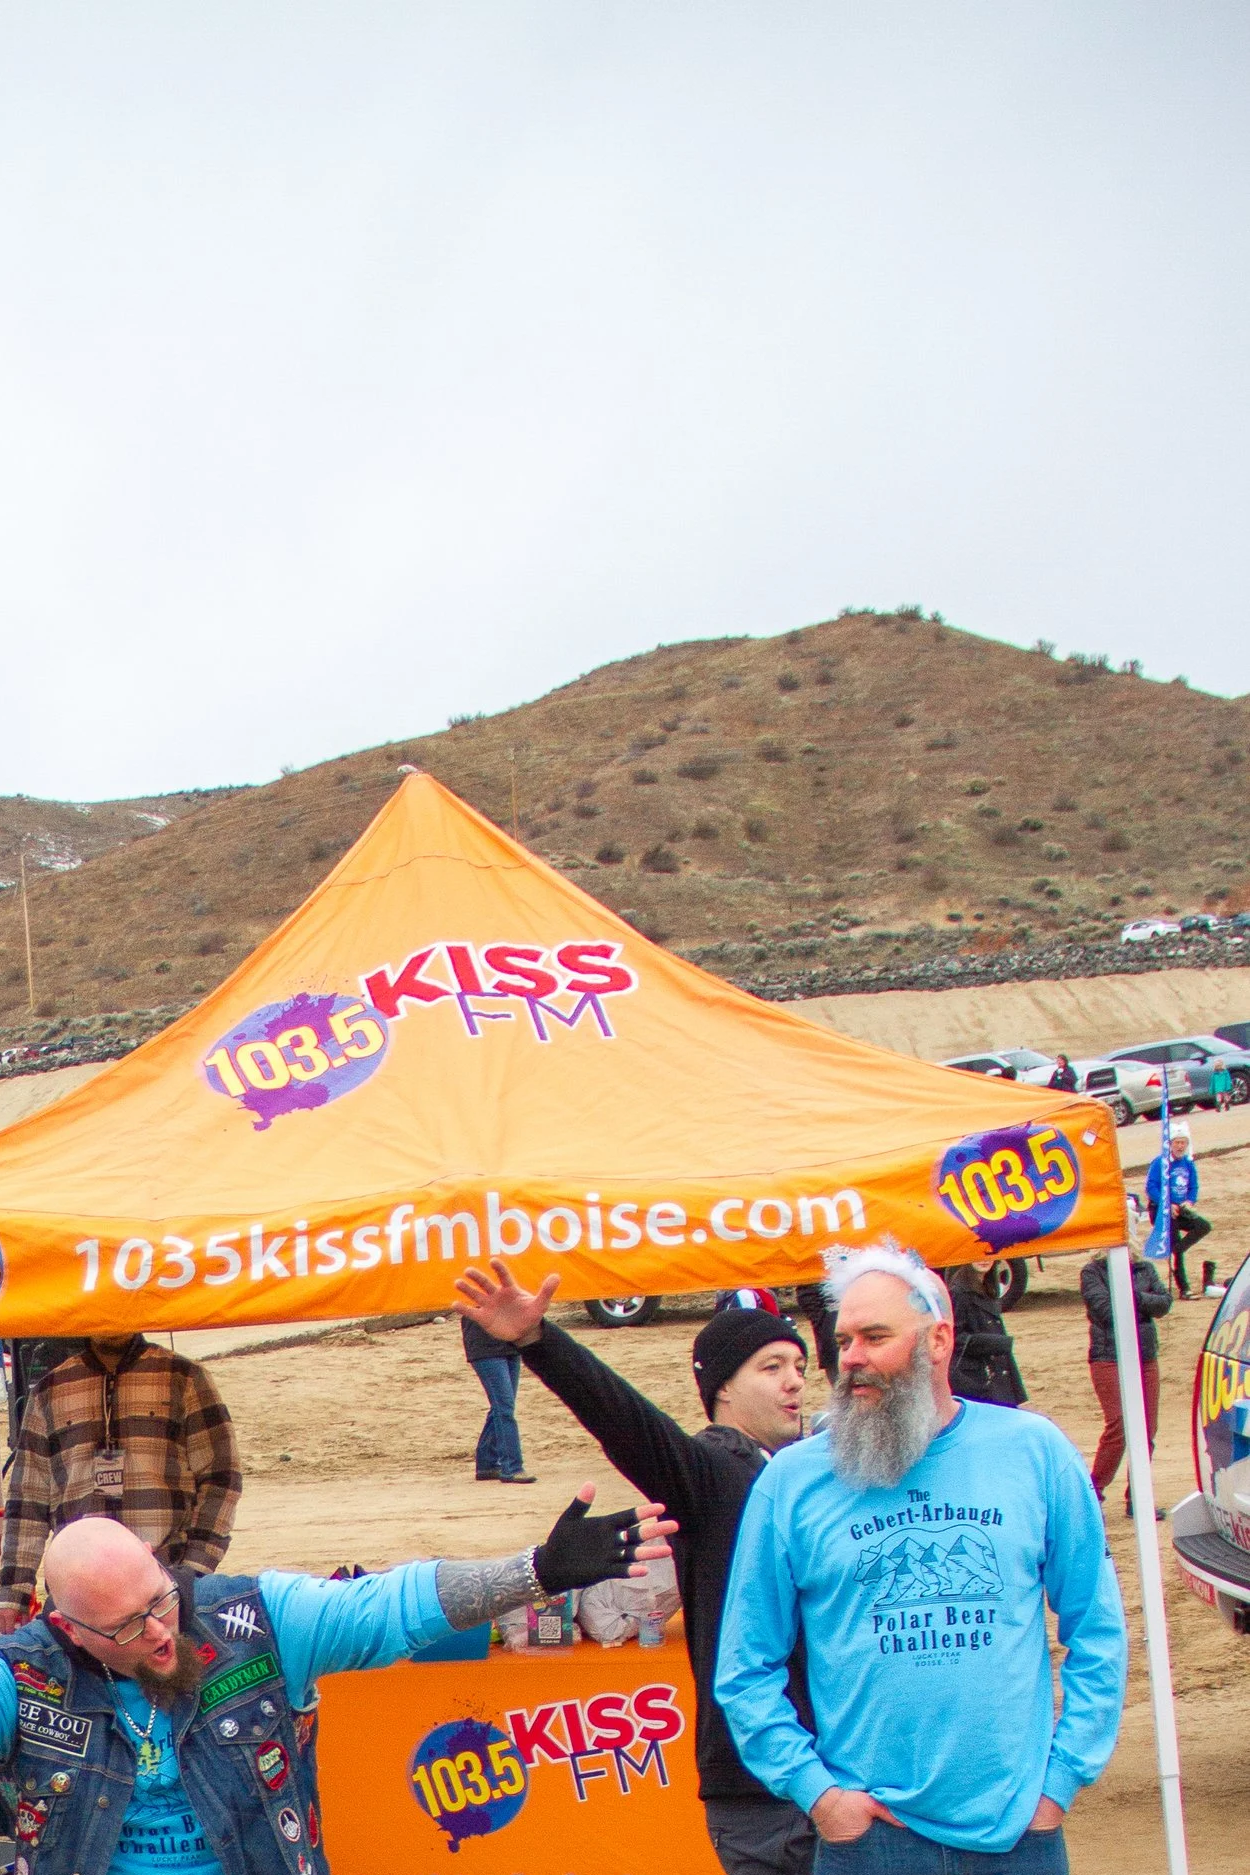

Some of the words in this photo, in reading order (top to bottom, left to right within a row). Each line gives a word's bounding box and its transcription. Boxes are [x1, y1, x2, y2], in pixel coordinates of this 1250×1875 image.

[363, 940, 638, 1020] KISS
[456, 990, 617, 1043] FM
[205, 1001, 388, 1099] 103.5
[937, 1127, 1078, 1230] 103.5
[73, 1187, 868, 1294] 1035kissfmboise.com
[96, 1471, 122, 1486] CREW
[907, 1488, 931, 1503] The
[850, 1503, 1004, 1541] Gebert-Arbaugh
[872, 1610, 933, 1634] Polar
[945, 1605, 996, 1626] Bear
[879, 1629, 992, 1655] Challenge
[47, 1710, 87, 1735] YOU
[505, 1683, 687, 1769] KISS
[412, 1739, 527, 1819] 103.5
[568, 1738, 671, 1804] FM
